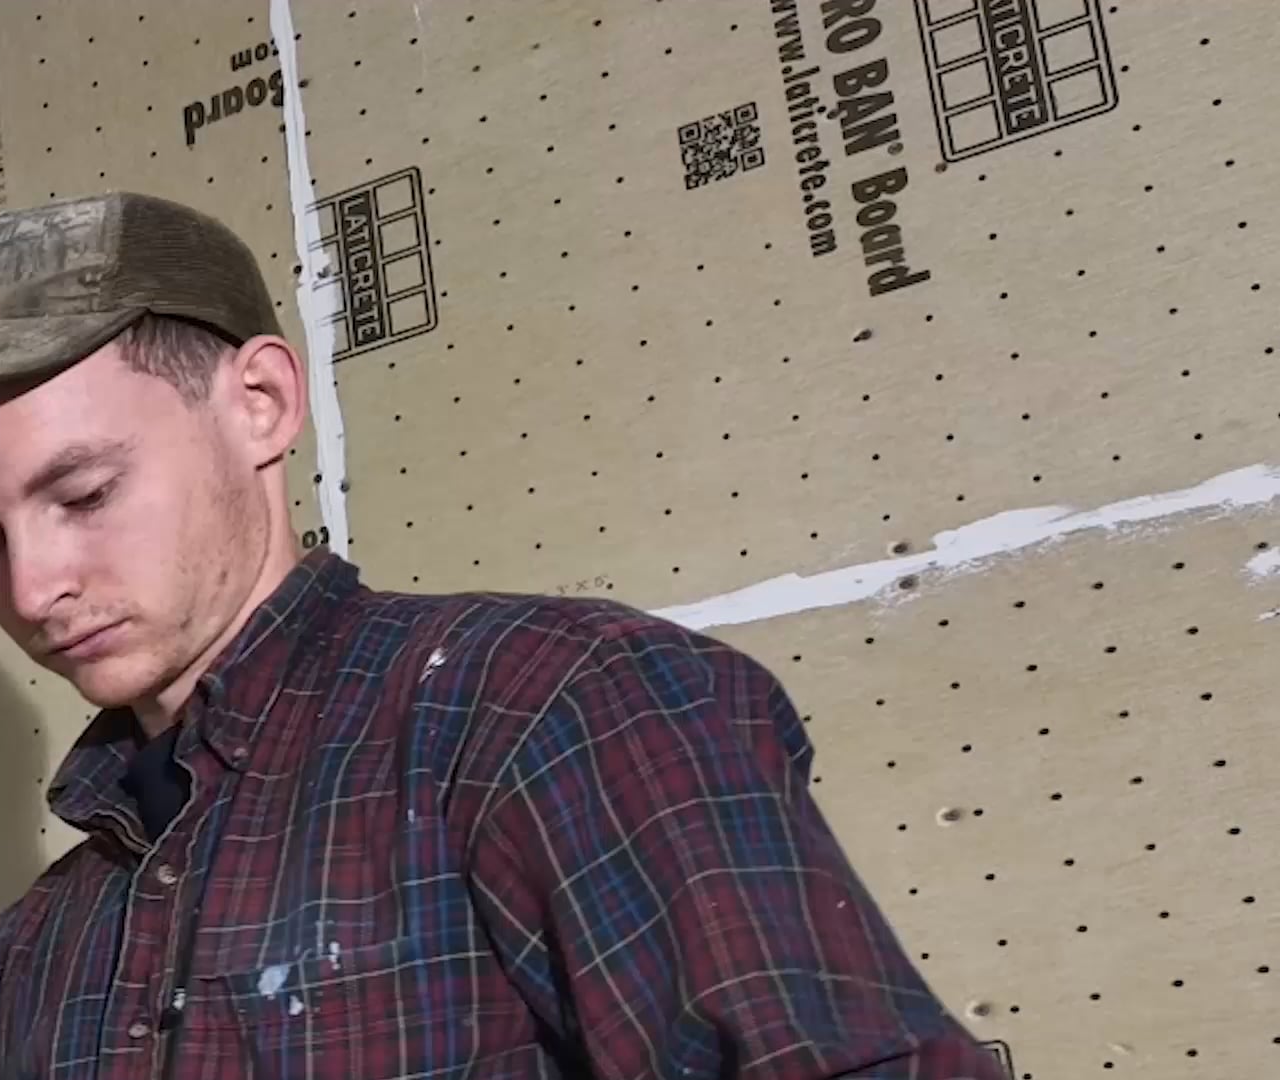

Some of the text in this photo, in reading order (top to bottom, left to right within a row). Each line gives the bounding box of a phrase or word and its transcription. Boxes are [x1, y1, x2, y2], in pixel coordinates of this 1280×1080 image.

[184, 68, 285, 147] Board
[988, 0, 1042, 129] TICRETE
[343, 196, 382, 344] LATICRETE
[851, 166, 932, 298] Board
